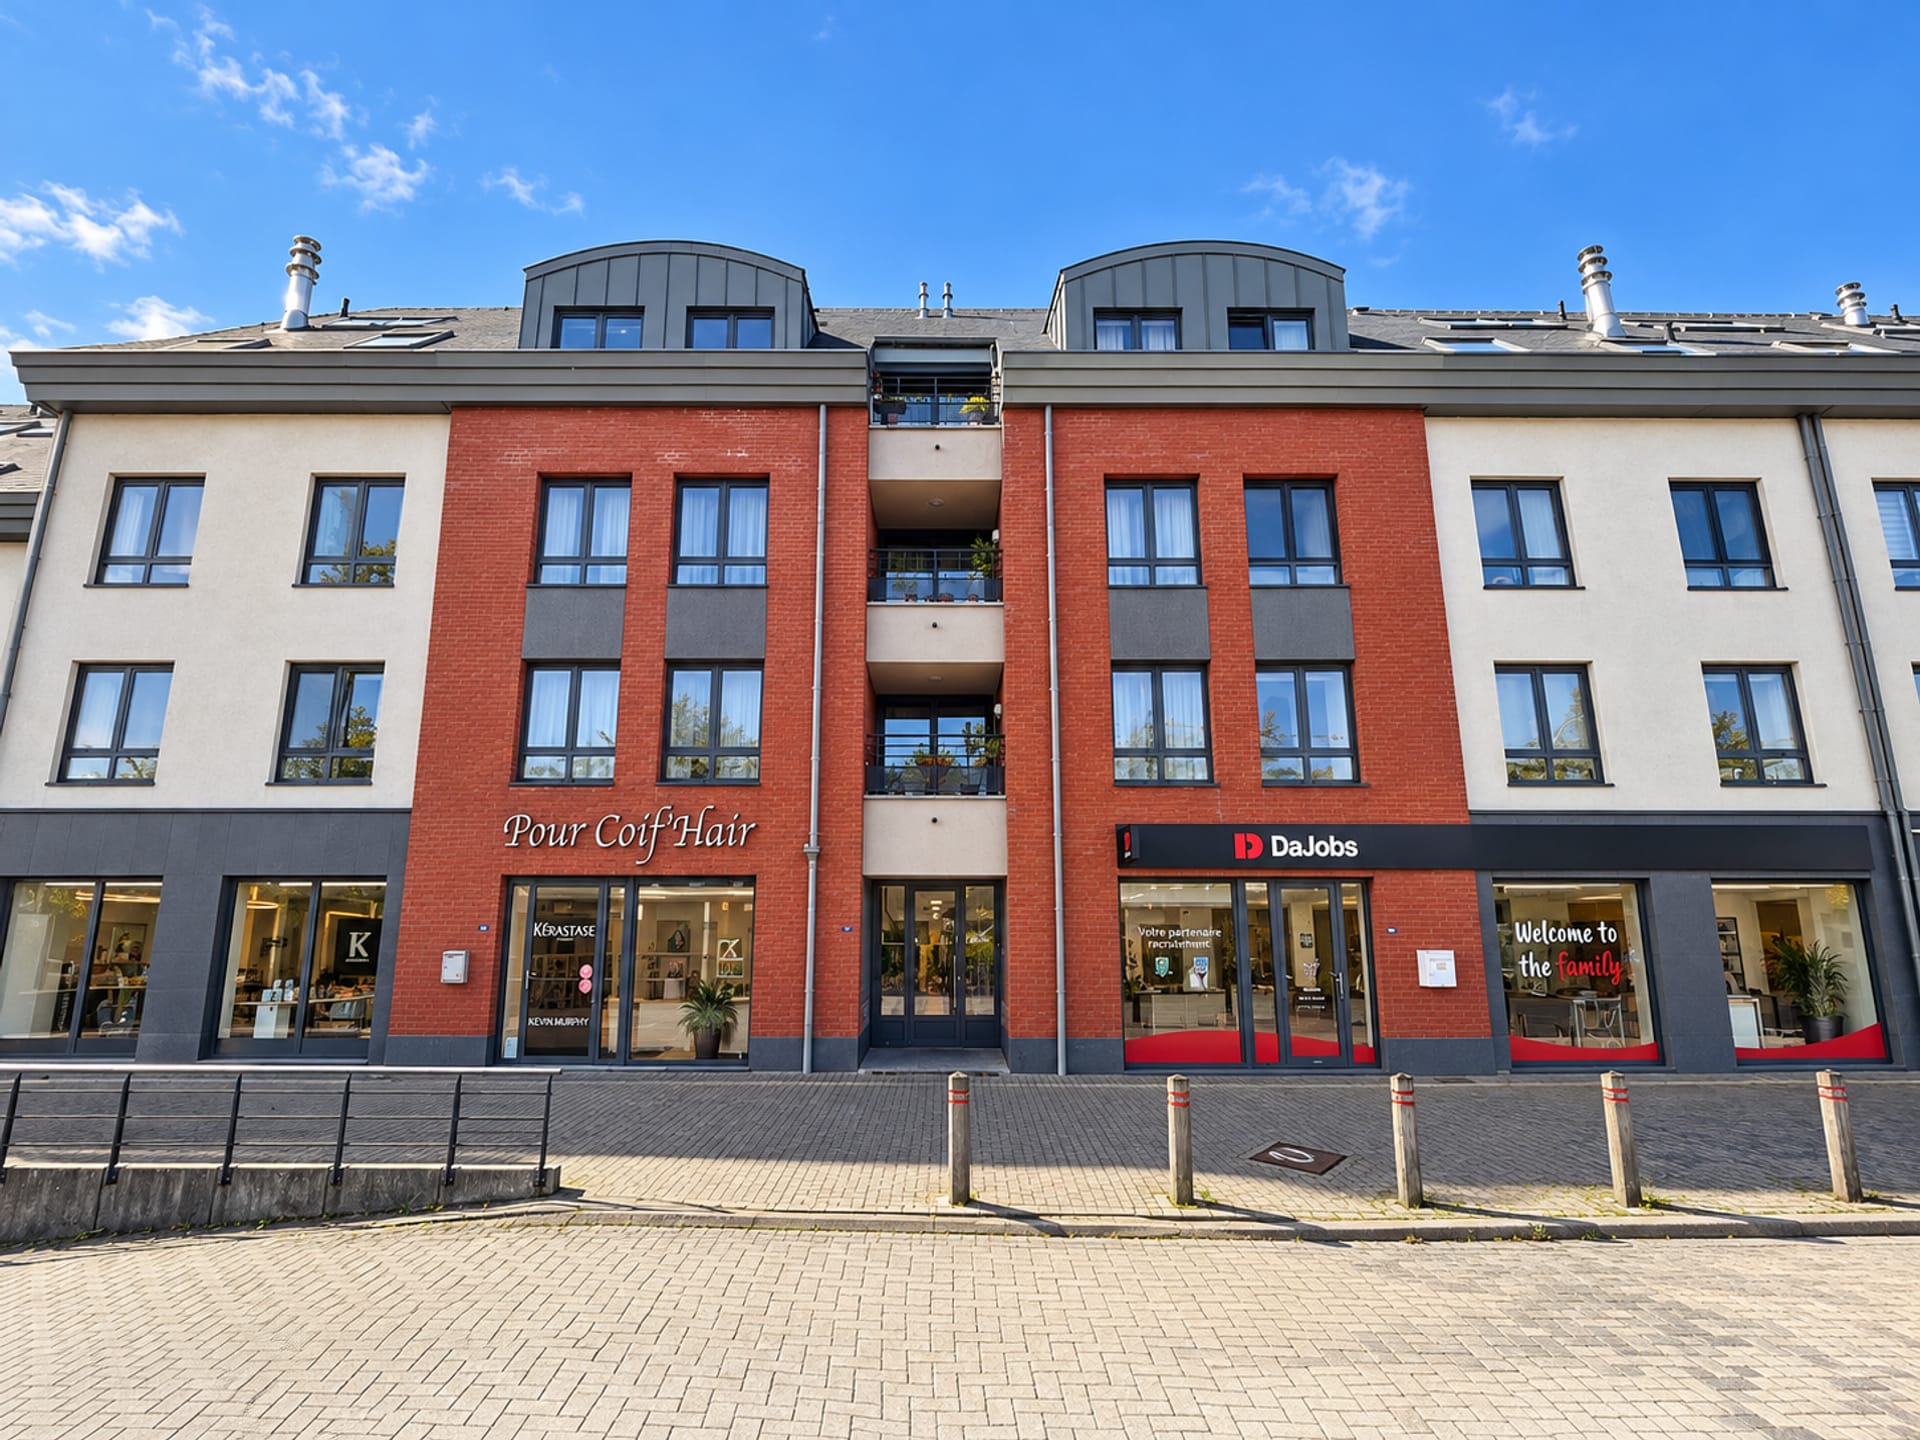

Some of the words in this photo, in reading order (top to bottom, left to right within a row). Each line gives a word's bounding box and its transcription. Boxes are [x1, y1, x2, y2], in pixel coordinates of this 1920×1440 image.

[503, 813, 587, 848] Pour
[595, 804, 756, 866] Coif'Hair
[1271, 834, 1359, 858] DaJobs
[348, 931, 372, 957] K
[1168, 927, 1222, 940] partenaire
[1515, 919, 1593, 945] Welcome
[1597, 920, 1618, 943] to
[1518, 951, 1552, 978] the
[1555, 950, 1621, 985] family
